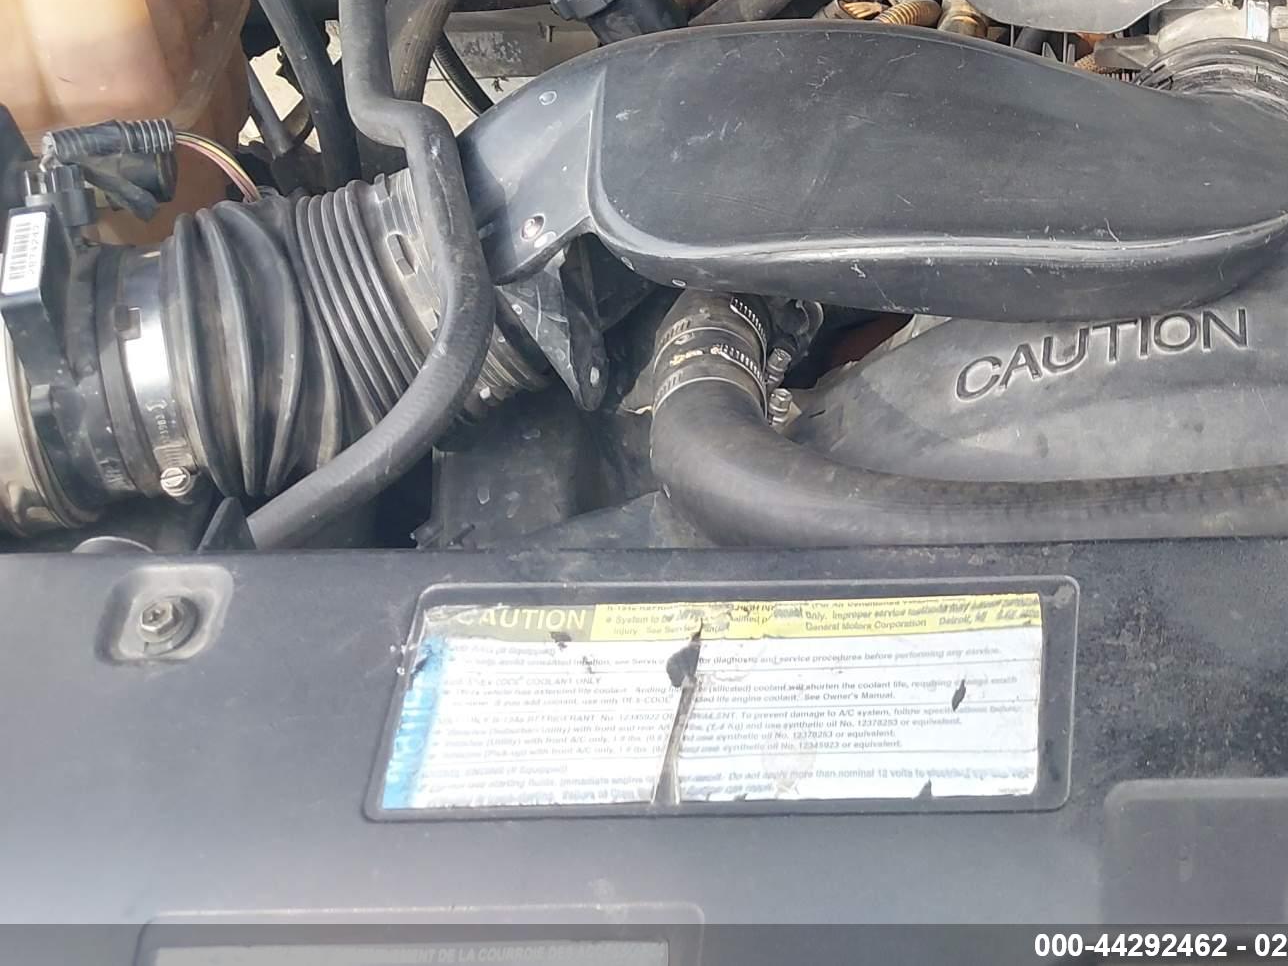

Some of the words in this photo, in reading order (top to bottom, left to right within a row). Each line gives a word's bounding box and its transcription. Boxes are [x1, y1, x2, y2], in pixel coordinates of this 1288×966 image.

[952, 307, 1249, 403] CAUTION
[455, 607, 586, 631] CAUTION
[806, 621, 840, 631] General
[874, 619, 927, 630] Corporation
[779, 654, 811, 664] service
[812, 653, 863, 664] procedures
[864, 652, 892, 661] before
[754, 683, 786, 692] coolant
[841, 681, 856, 690] the
[858, 680, 890, 690] coolant
[731, 694, 761, 703] engine
[804, 693, 820, 701] See
[823, 691, 859, 701] Owner's
[861, 691, 896, 700] Manual.
[783, 720, 824, 730] synthetic
[838, 768, 875, 779] nominal
[458, 947, 477, 962] LA
